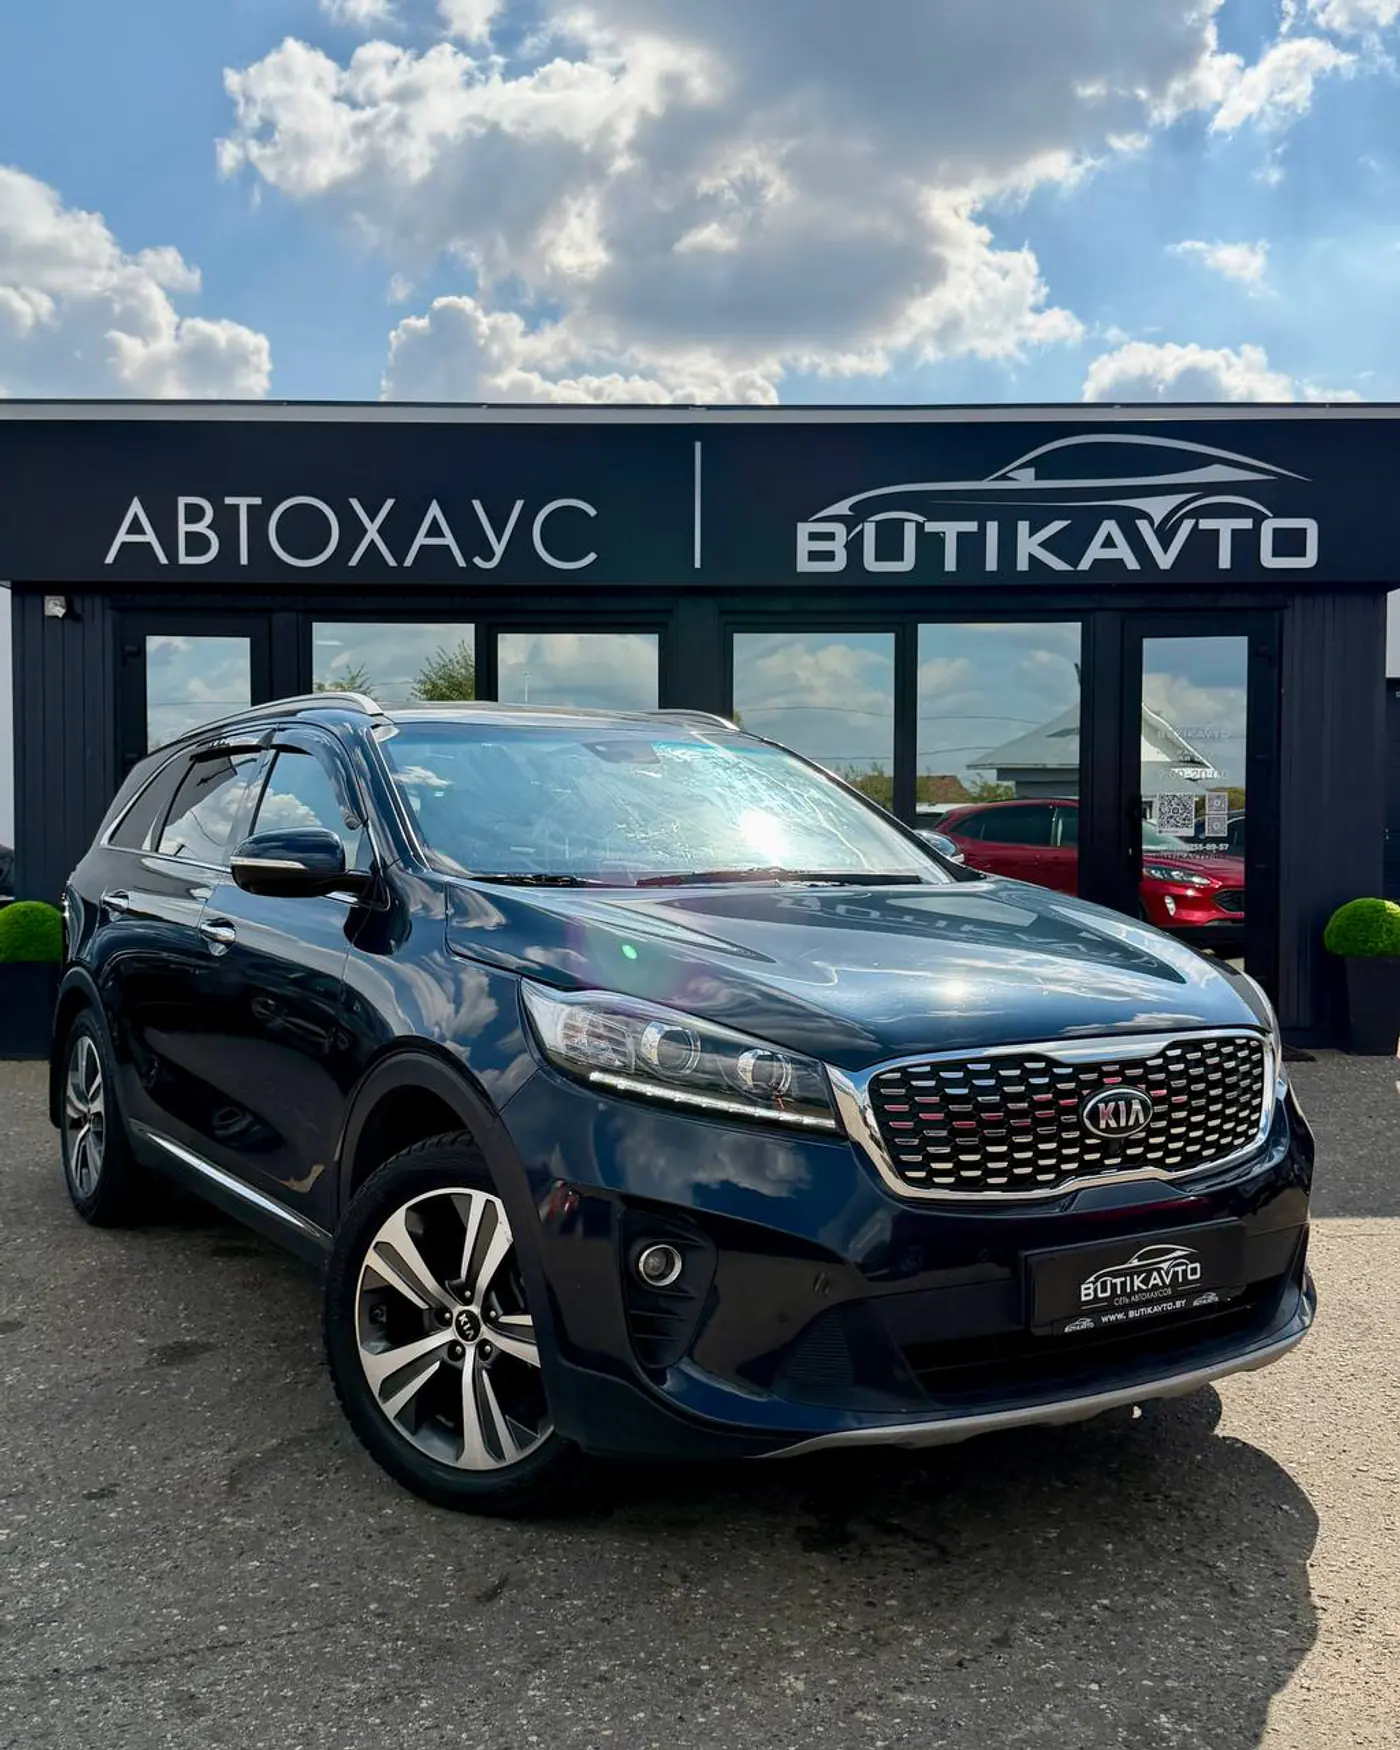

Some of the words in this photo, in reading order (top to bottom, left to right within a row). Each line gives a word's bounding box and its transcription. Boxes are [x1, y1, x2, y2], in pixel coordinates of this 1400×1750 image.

[103, 495, 599, 570] АВТОХАУС
[796, 517, 1319, 573] BUTIKAVTO
[1098, 1099, 1145, 1129] KIA
[1080, 1262, 1201, 1301] BUTIKAVTO
